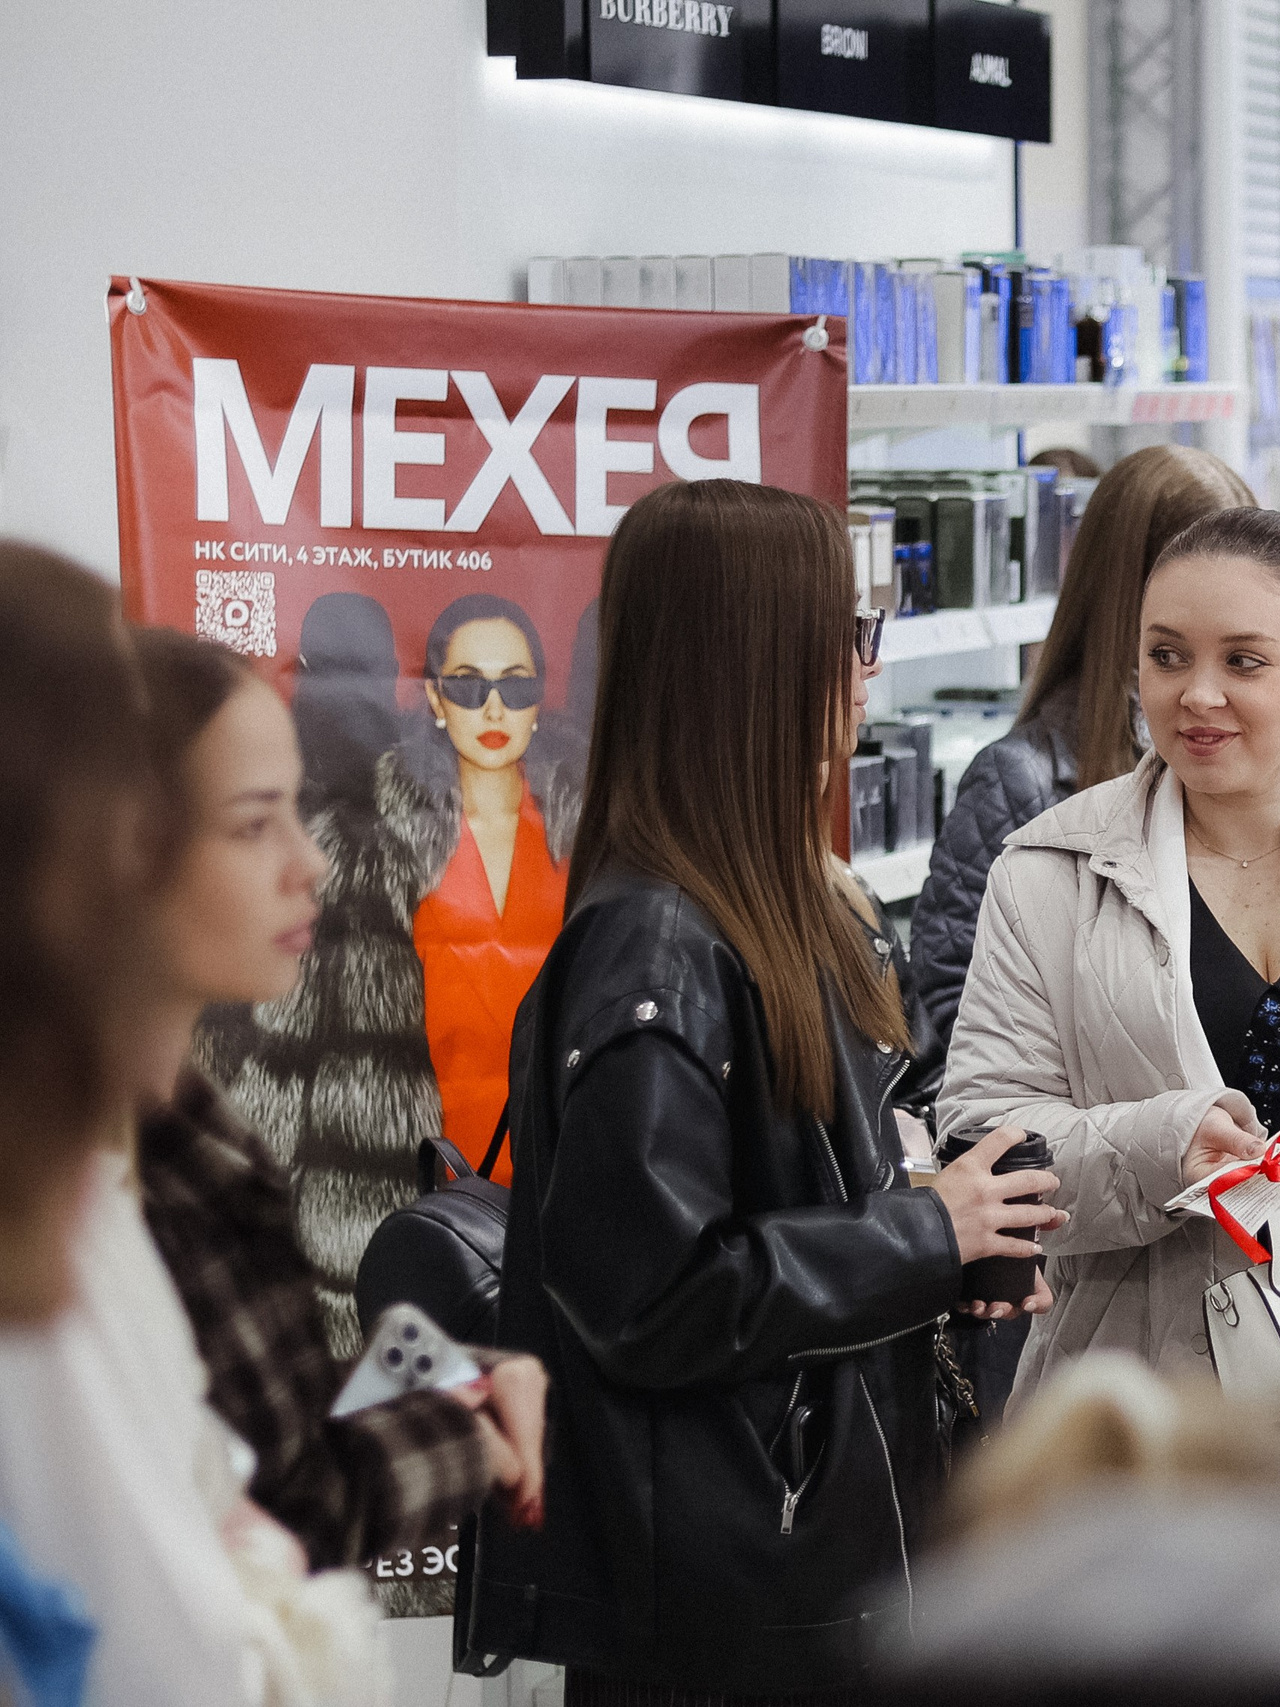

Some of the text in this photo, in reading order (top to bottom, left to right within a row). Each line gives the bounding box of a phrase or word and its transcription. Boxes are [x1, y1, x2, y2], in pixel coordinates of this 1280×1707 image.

[599, 0, 734, 37] BURBERRY
[195, 540, 493, 571] НК СИТИ, 4 ЭТАЖ, БУТИК 406
